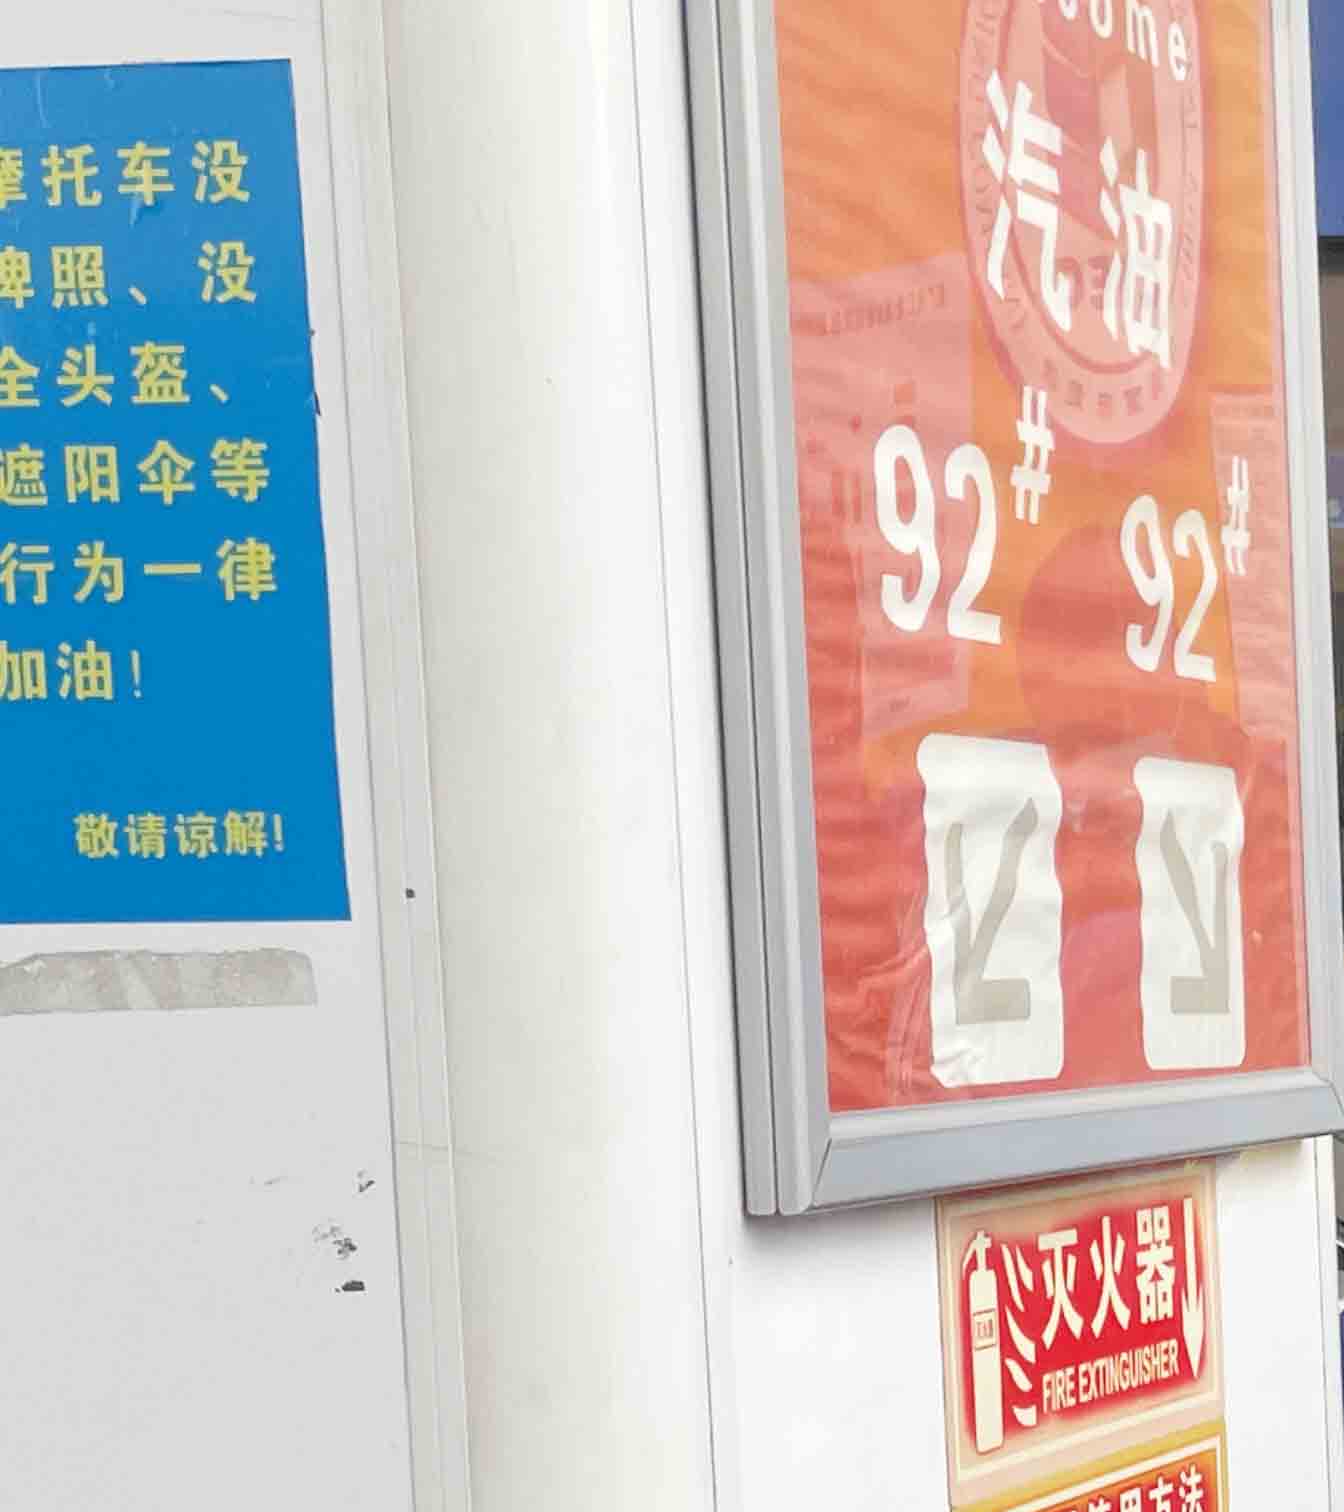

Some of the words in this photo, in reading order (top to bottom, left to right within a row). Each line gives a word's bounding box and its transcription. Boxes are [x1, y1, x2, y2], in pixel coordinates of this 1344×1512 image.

[981, 69, 1174, 368] 汽油
[0, 437, 271, 507] 遮阳伞等
[873, 385, 1056, 646] 92#
[0, 538, 278, 604] 行为一律
[1120, 455, 1252, 684] 92#
[1037, 1205, 1177, 1351] 灭火器
[1042, 1365, 1077, 1414] FIRE
[1078, 1338, 1181, 1404] EXTINGUISHER
